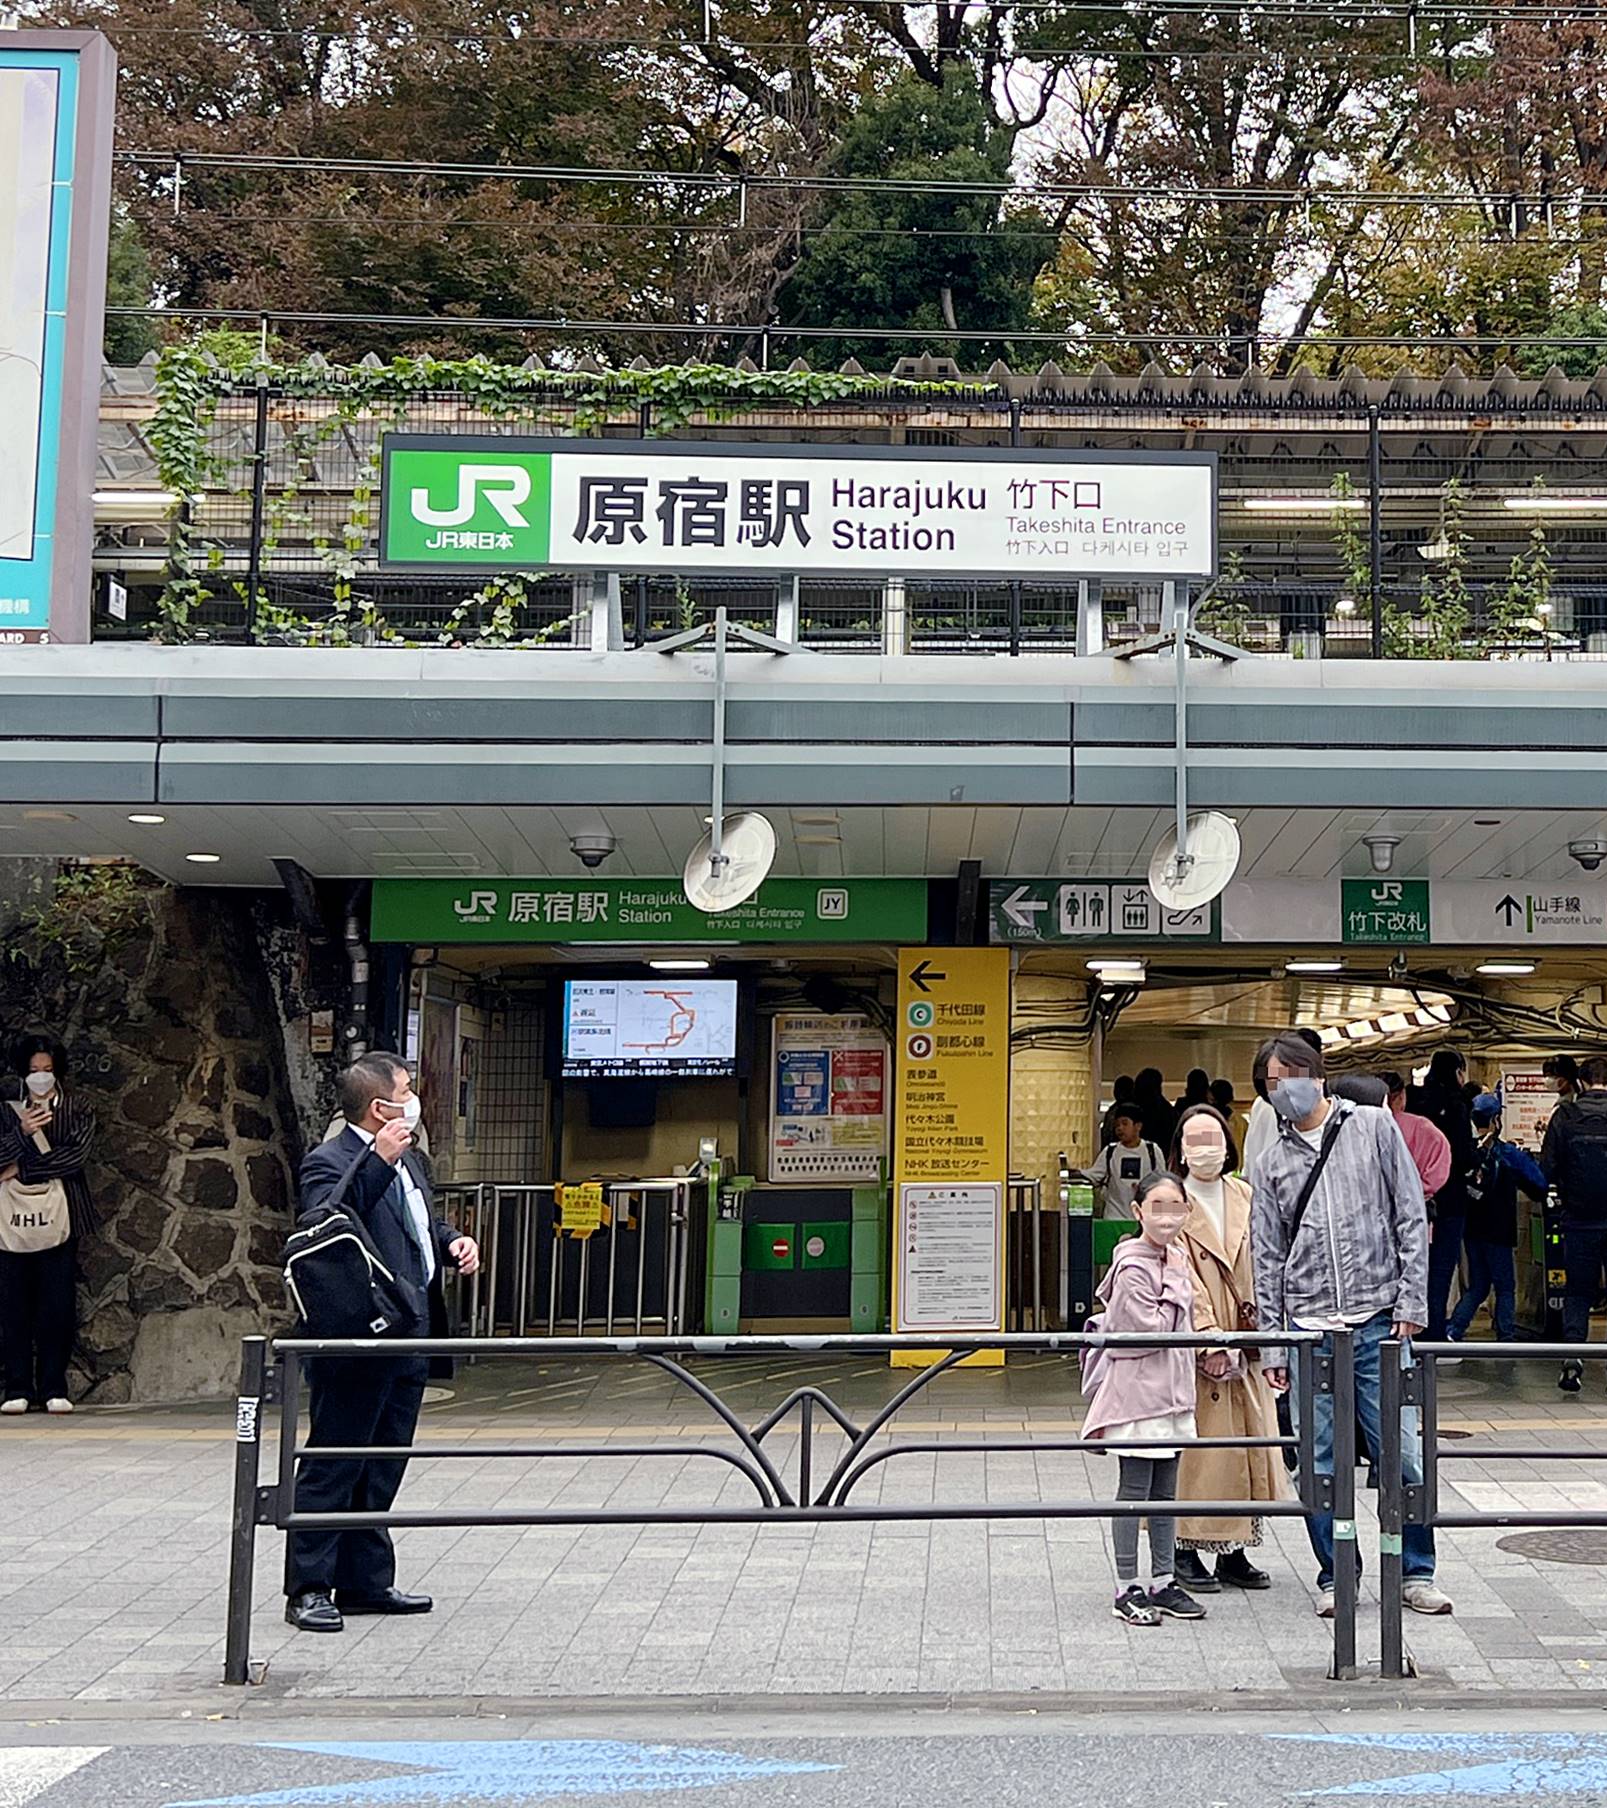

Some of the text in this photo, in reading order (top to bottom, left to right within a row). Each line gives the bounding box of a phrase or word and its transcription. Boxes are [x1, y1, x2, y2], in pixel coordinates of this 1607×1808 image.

[411, 464, 531, 528] JR
[831, 478, 987, 517] Harajuku
[1006, 478, 1102, 510] 竹下口
[572, 476, 812, 548] 原宿駅
[1006, 516, 1186, 535] Takeshita Entrance
[426, 531, 513, 550] JR東日本
[831, 519, 955, 551] Station
[1006, 540, 1069, 556] 竹下入口
[1082, 540, 1189, 558] 다케시타 입구
[619, 891, 688, 908] Harajuku
[1371, 882, 1403, 900] JR
[454, 891, 497, 914] JR
[508, 892, 608, 923] 原宿駅
[824, 898, 841, 909] JY
[1533, 896, 1581, 912] 山手線
[619, 909, 672, 923] Station
[1349, 912, 1426, 931] 竹下改札
[1535, 915, 1602, 925] Yamanote Line
[937, 1004, 985, 1016] 千代田線
[906, 1114, 955, 1125] 代々木公園
[905, 1160, 929, 1169] NHK
